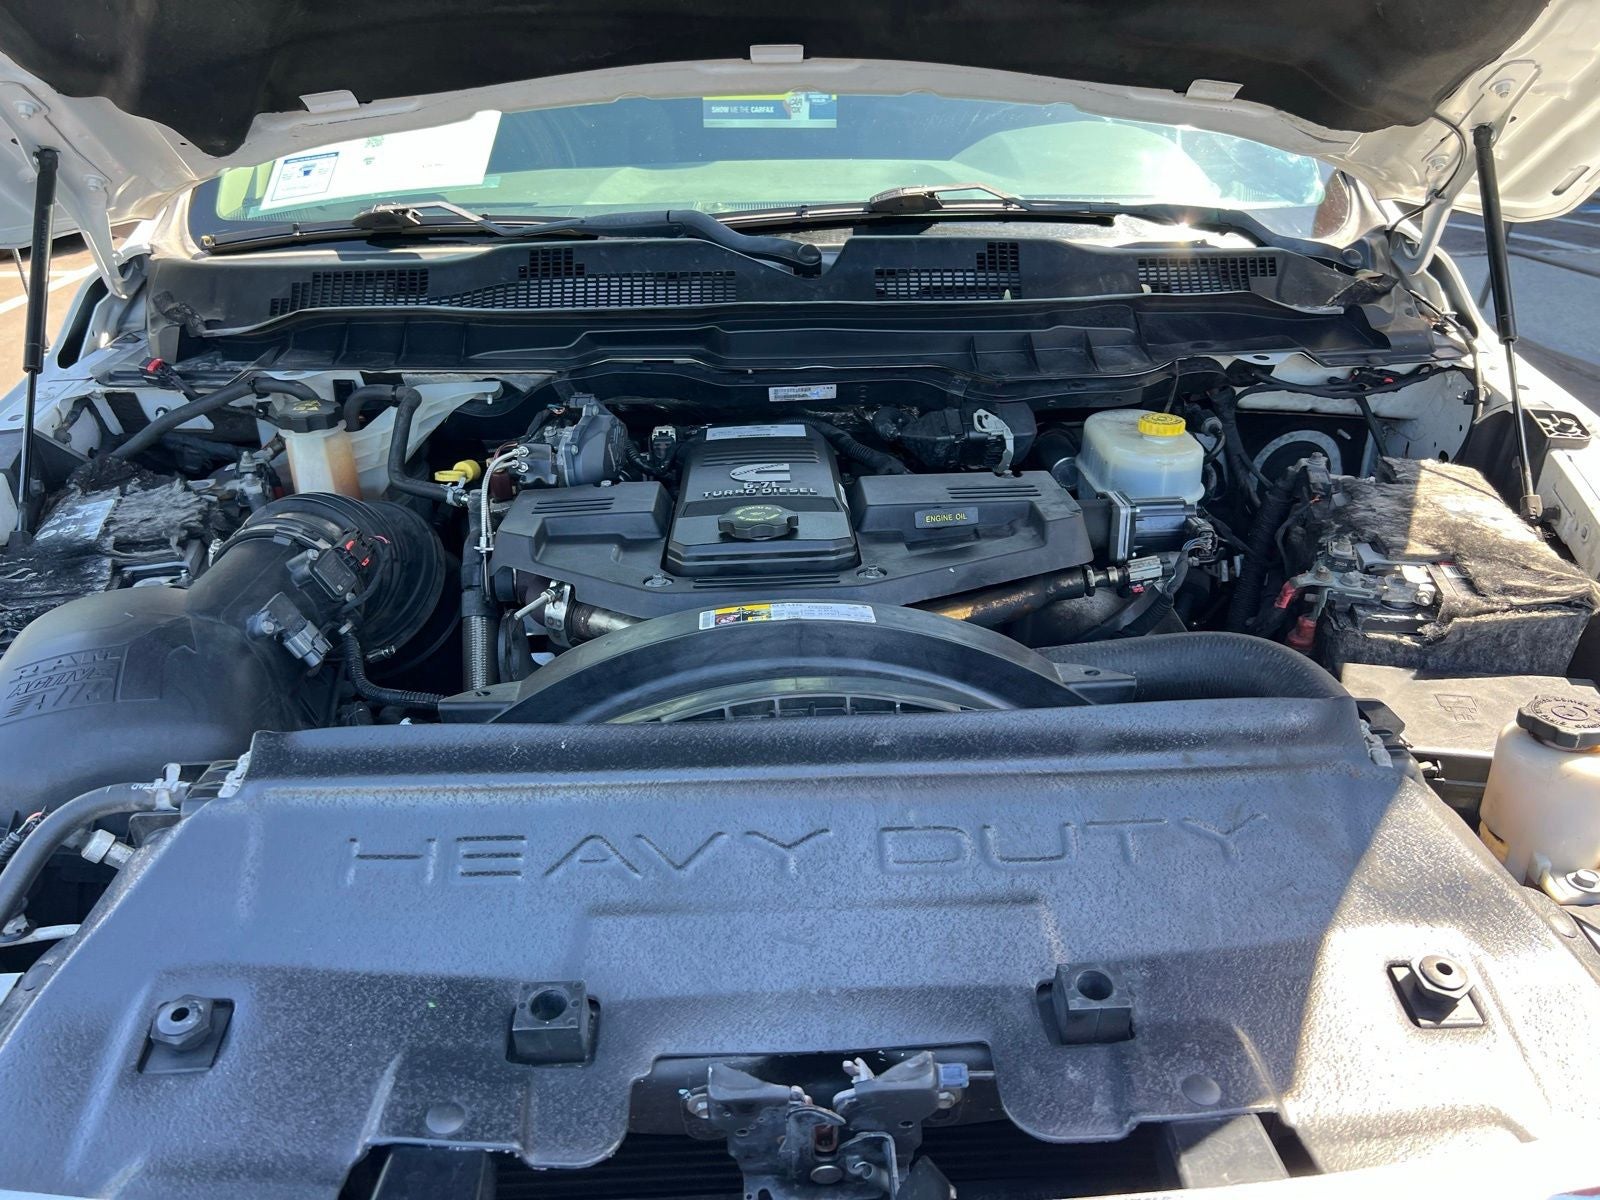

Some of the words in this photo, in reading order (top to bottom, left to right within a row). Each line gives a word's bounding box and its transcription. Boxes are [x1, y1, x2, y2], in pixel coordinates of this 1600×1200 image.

[711, 106, 730, 114] SHOW
[730, 106, 739, 114] ME
[739, 106, 751, 114] THE
[751, 106, 774, 114] CARFAX
[743, 481, 780, 490] 6.7L
[703, 488, 757, 499] TURBO
[761, 486, 818, 496] DIESEL
[925, 513, 953, 523] ENGINE
[955, 513, 968, 521] OIL
[346, 830, 832, 885] HEAVY
[879, 812, 1269, 873] DUTY
